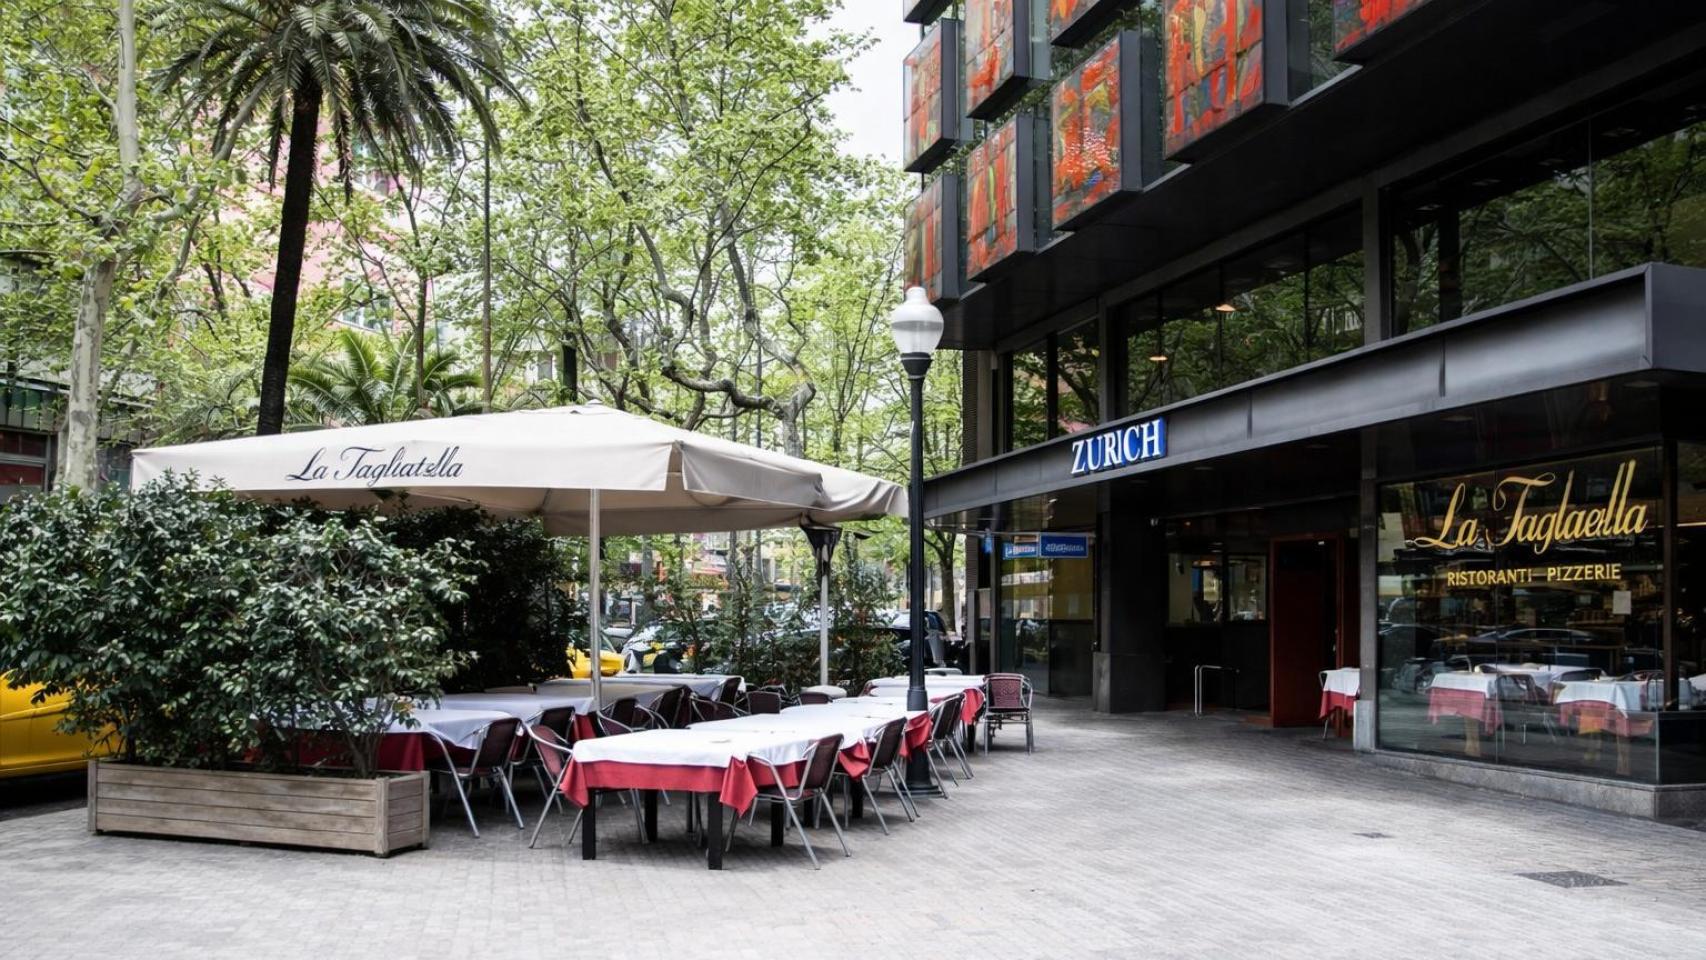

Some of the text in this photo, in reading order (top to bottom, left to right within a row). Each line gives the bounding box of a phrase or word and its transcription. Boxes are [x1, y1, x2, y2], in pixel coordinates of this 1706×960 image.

[285, 447, 328, 481] La
[1071, 419, 1161, 474] ZURICH
[1412, 482, 1478, 550] La
[1447, 563, 1622, 587] RISTORANTI PIZZERIE
